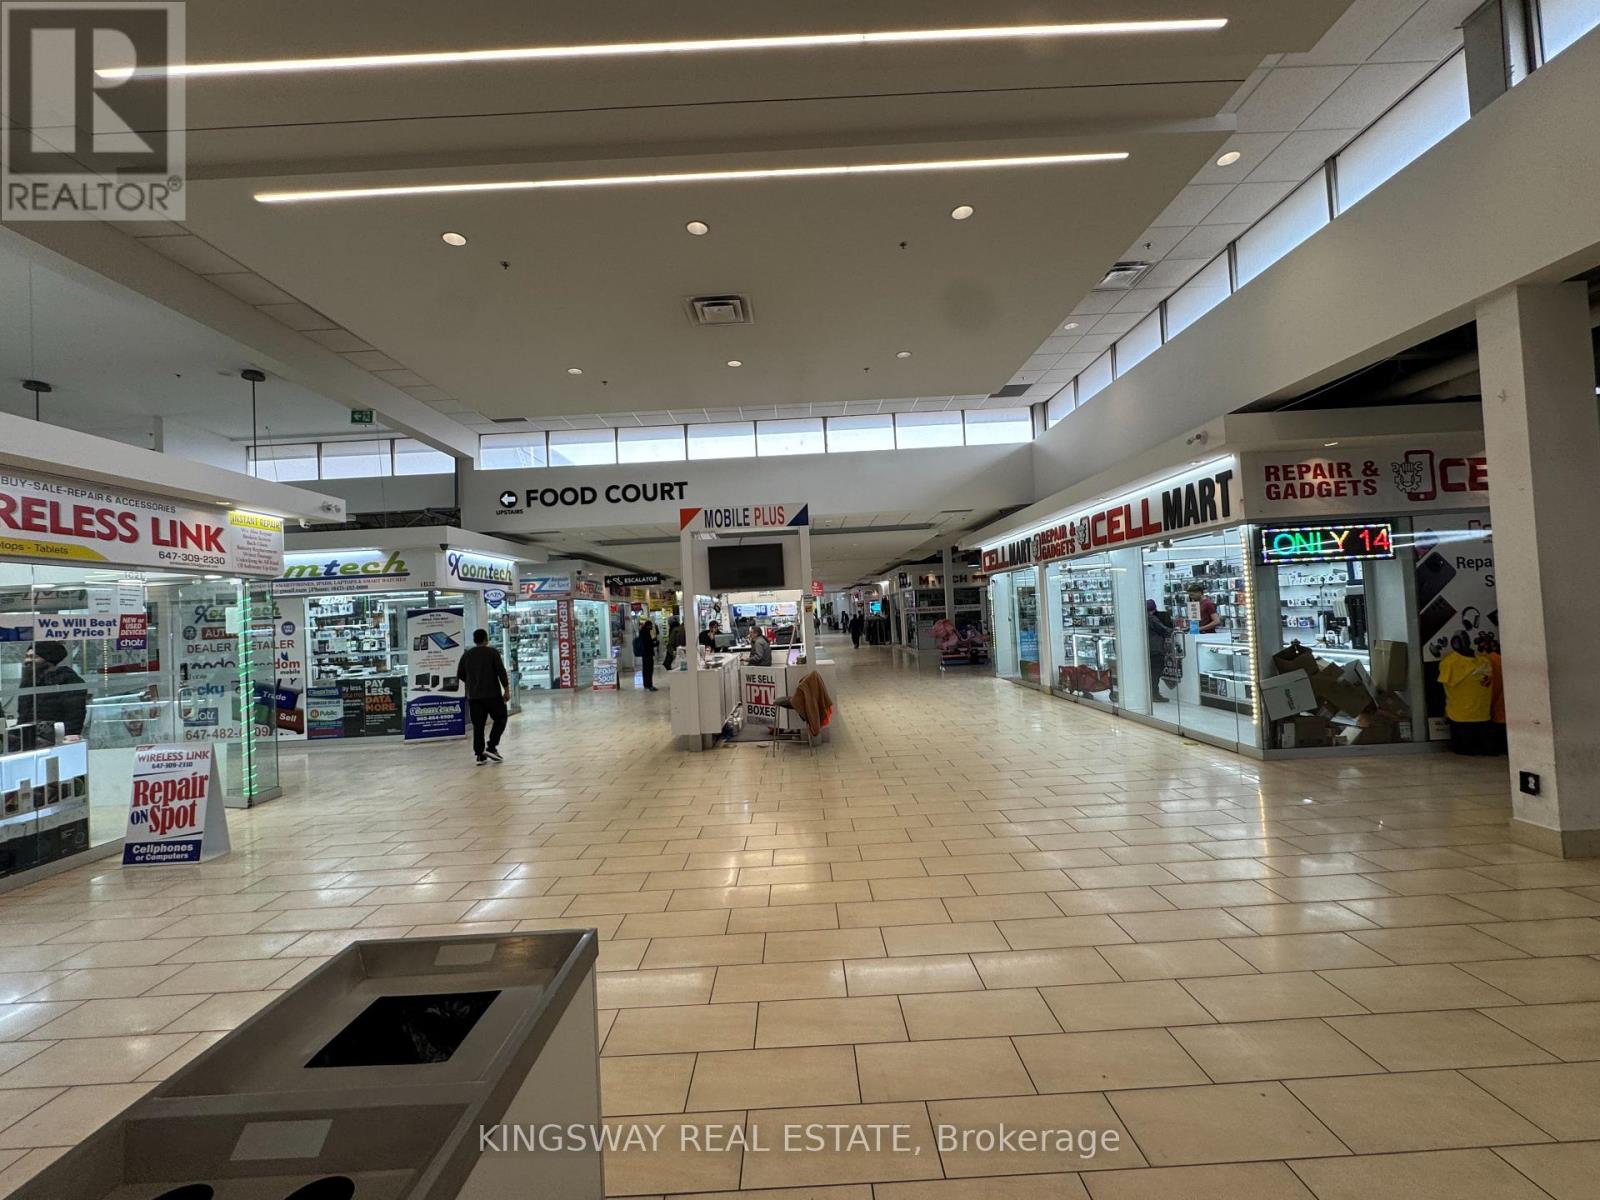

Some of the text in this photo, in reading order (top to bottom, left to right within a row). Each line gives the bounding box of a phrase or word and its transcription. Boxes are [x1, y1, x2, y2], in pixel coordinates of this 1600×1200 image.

[1265, 460, 1380, 482] REPAIR &
[527, 482, 688, 507] FOOD COURT
[1266, 479, 1378, 500] GADGETS
[115, 497, 176, 513] ACCESSORIES
[1091, 470, 1232, 546] CELL MART
[705, 506, 785, 528] MOBILE PLUS
[151, 516, 227, 553] LINK
[1041, 522, 1076, 545] REPAIR &
[1359, 529, 1390, 551] 14
[34, 544, 69, 554] Tablets
[983, 537, 1031, 572] CELL MART
[1041, 538, 1076, 560] GADGETS
[159, 551, 225, 565] 647-309-2330
[448, 553, 512, 582] Xoomtech
[624, 576, 658, 584] ESCALATOR
[38, 618, 117, 628] We Will Beat
[45, 629, 69, 639] Any
[73, 628, 104, 637] Price
[187, 643, 231, 653] DEALER
[559, 601, 571, 687] REPAIR ON SPOT
[364, 680, 385, 688] PAY
[746, 674, 775, 684] WE SELL
[263, 691, 286, 701] Trade
[365, 687, 393, 696] LESS.
[746, 685, 776, 705] IPTV
[366, 695, 392, 704] DATA
[280, 713, 297, 722] Sell
[747, 705, 776, 717] BOXES
[186, 727, 269, 740] 647-482-09
[138, 750, 210, 762] WIRELESS LINK
[132, 772, 208, 807] Repair
[130, 800, 197, 835] ON Spot
[133, 844, 193, 854] Cellphones
[145, 853, 188, 862] Computers
